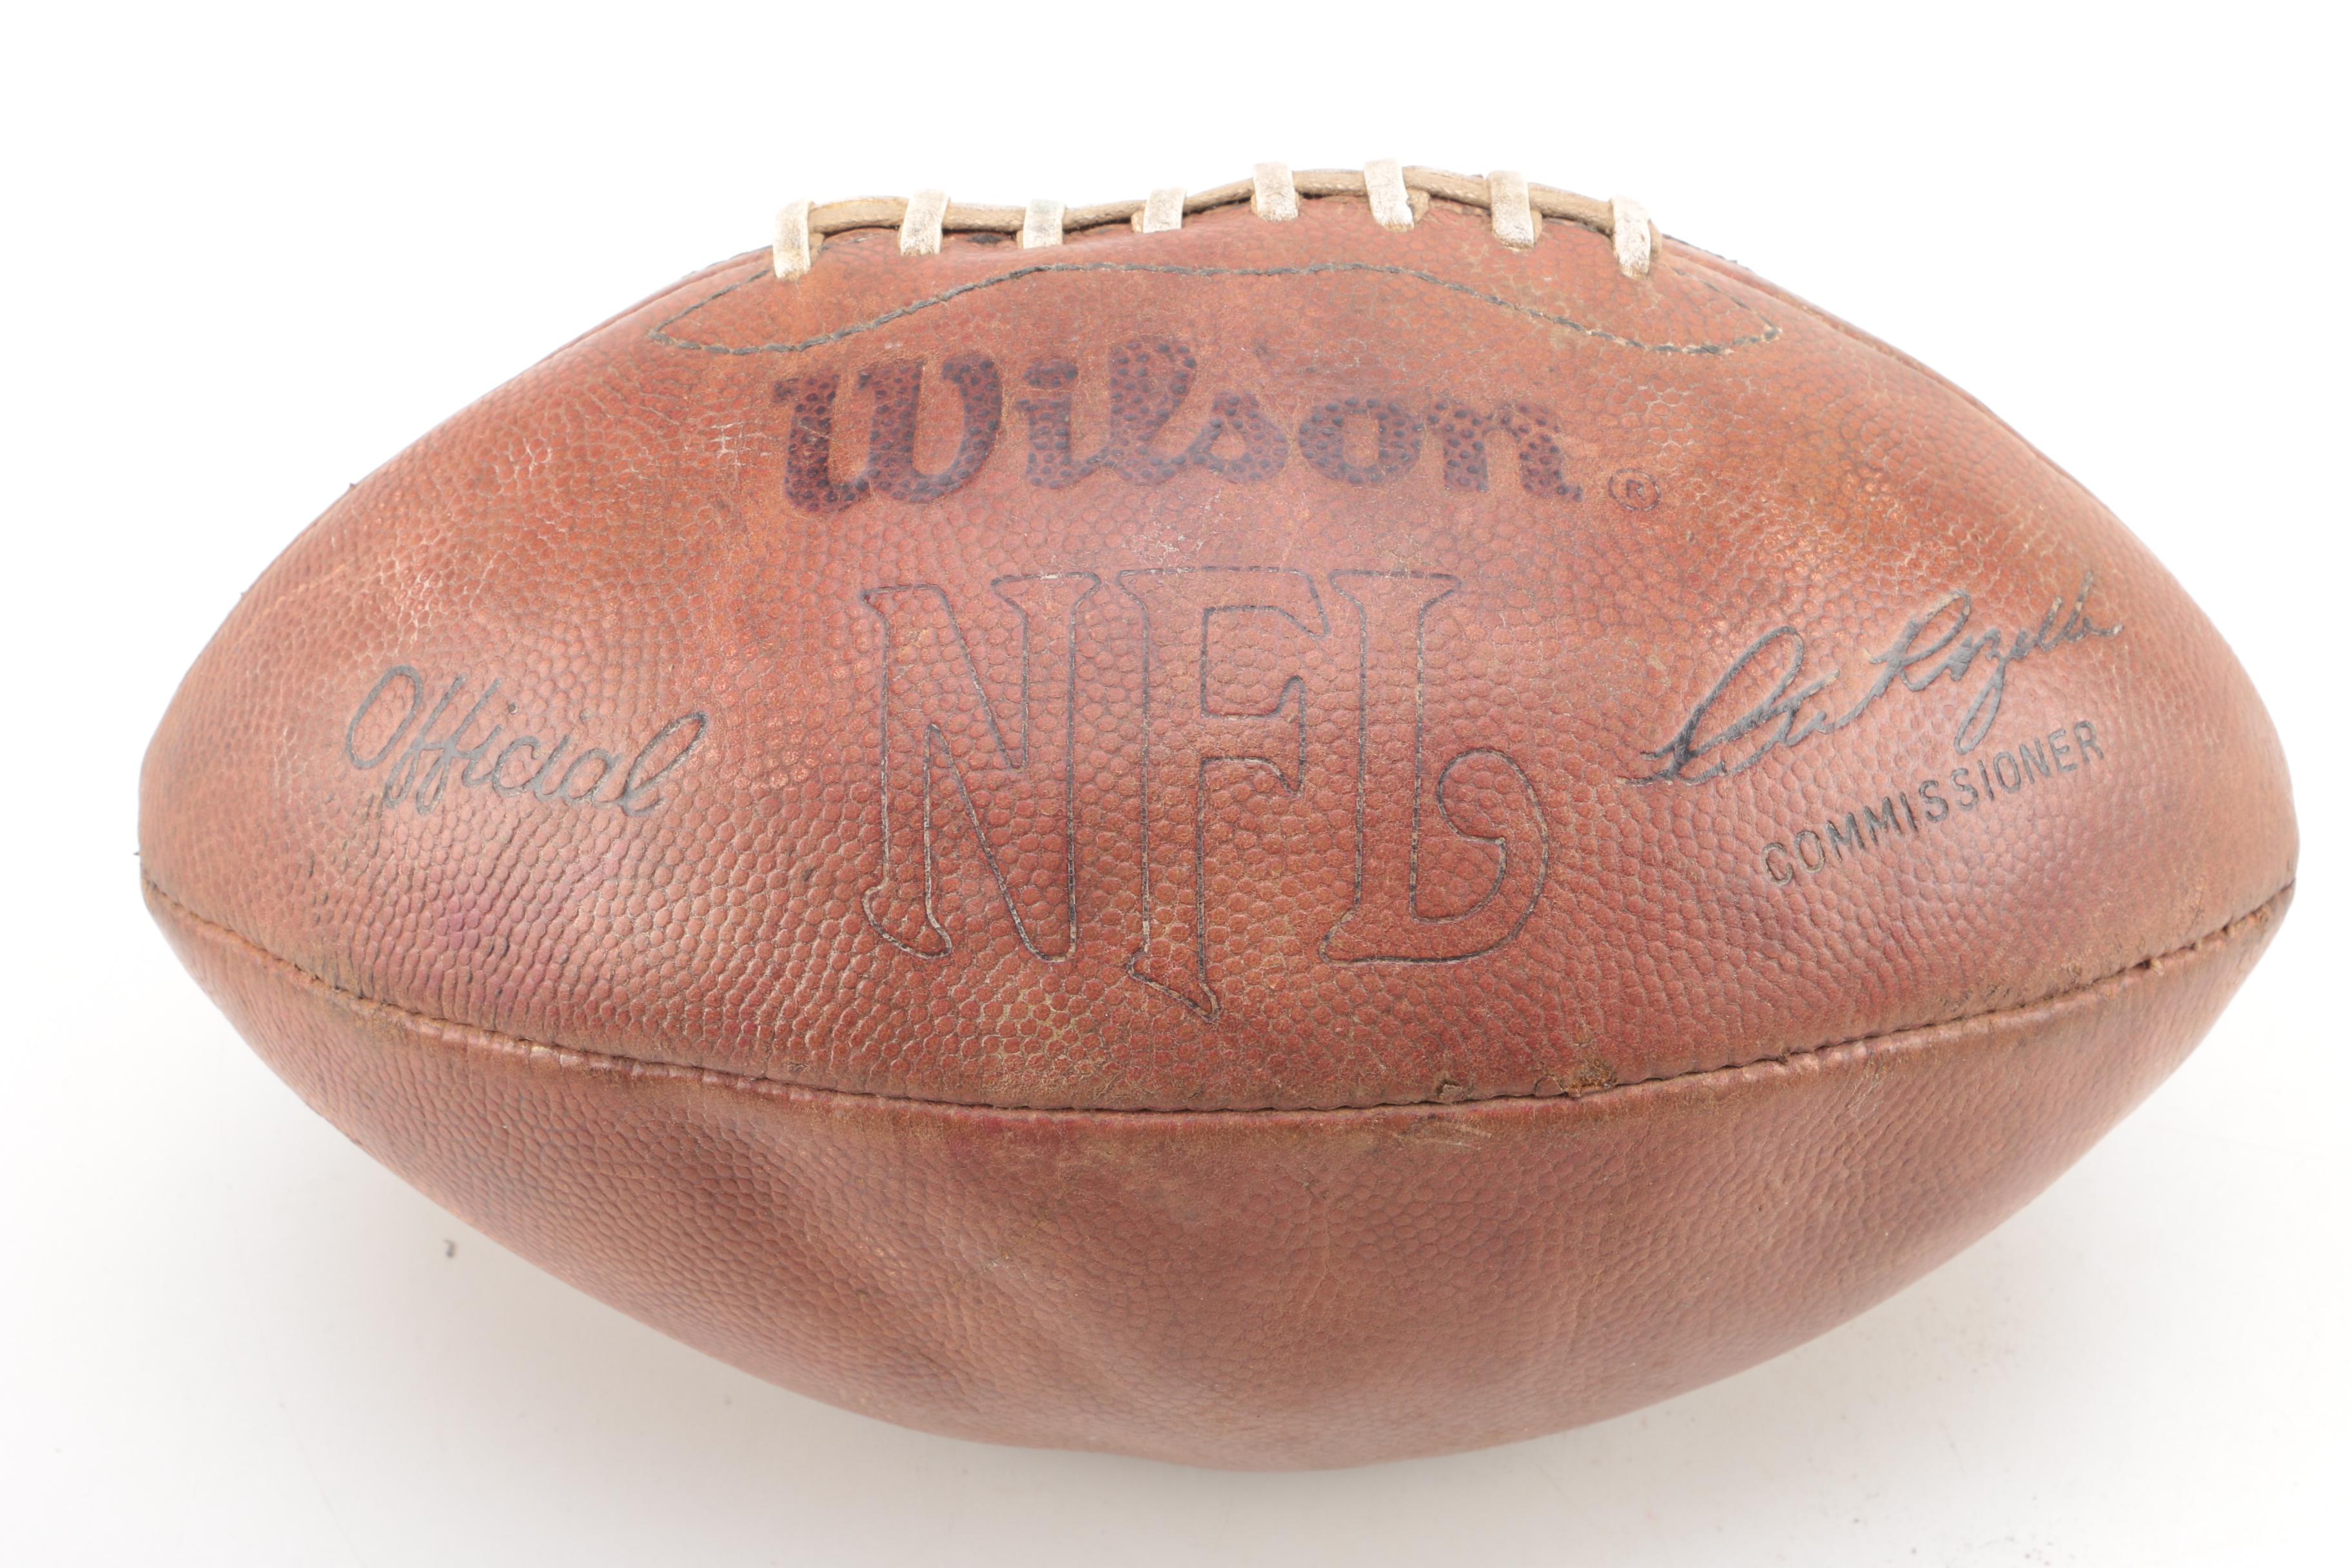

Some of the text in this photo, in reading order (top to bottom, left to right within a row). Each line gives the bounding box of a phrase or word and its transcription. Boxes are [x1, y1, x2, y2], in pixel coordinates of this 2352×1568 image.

[776, 338, 1583, 514] Wilson
[346, 664, 708, 817] Official
[860, 566, 1549, 1023] NFL
[1761, 720, 2105, 887] COMMISSIONER
